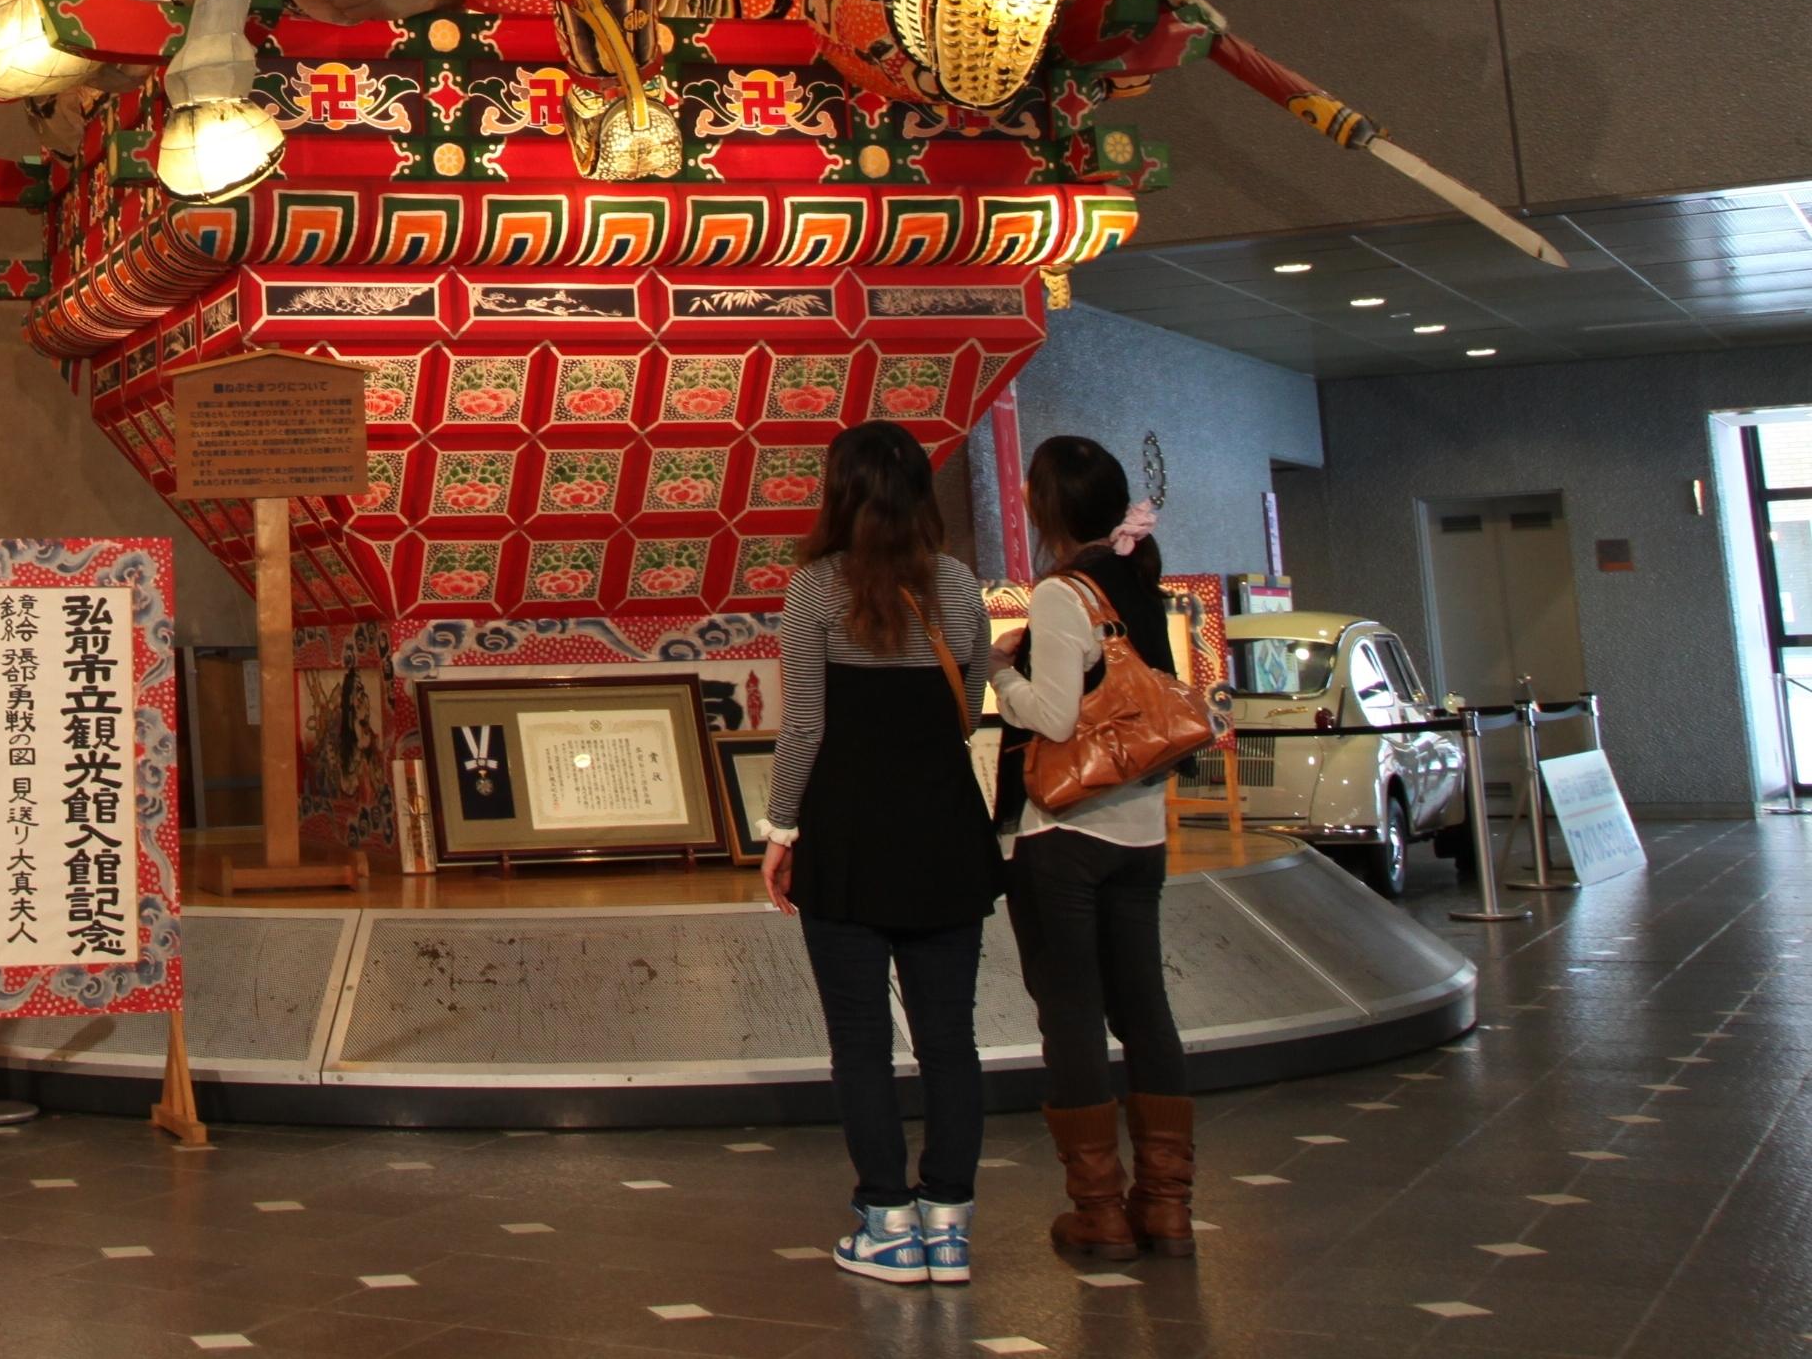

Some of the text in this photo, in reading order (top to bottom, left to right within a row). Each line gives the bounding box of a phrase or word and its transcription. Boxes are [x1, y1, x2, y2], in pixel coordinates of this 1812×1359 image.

[60, 594, 126, 957] 弘前市立観光館入館記念
